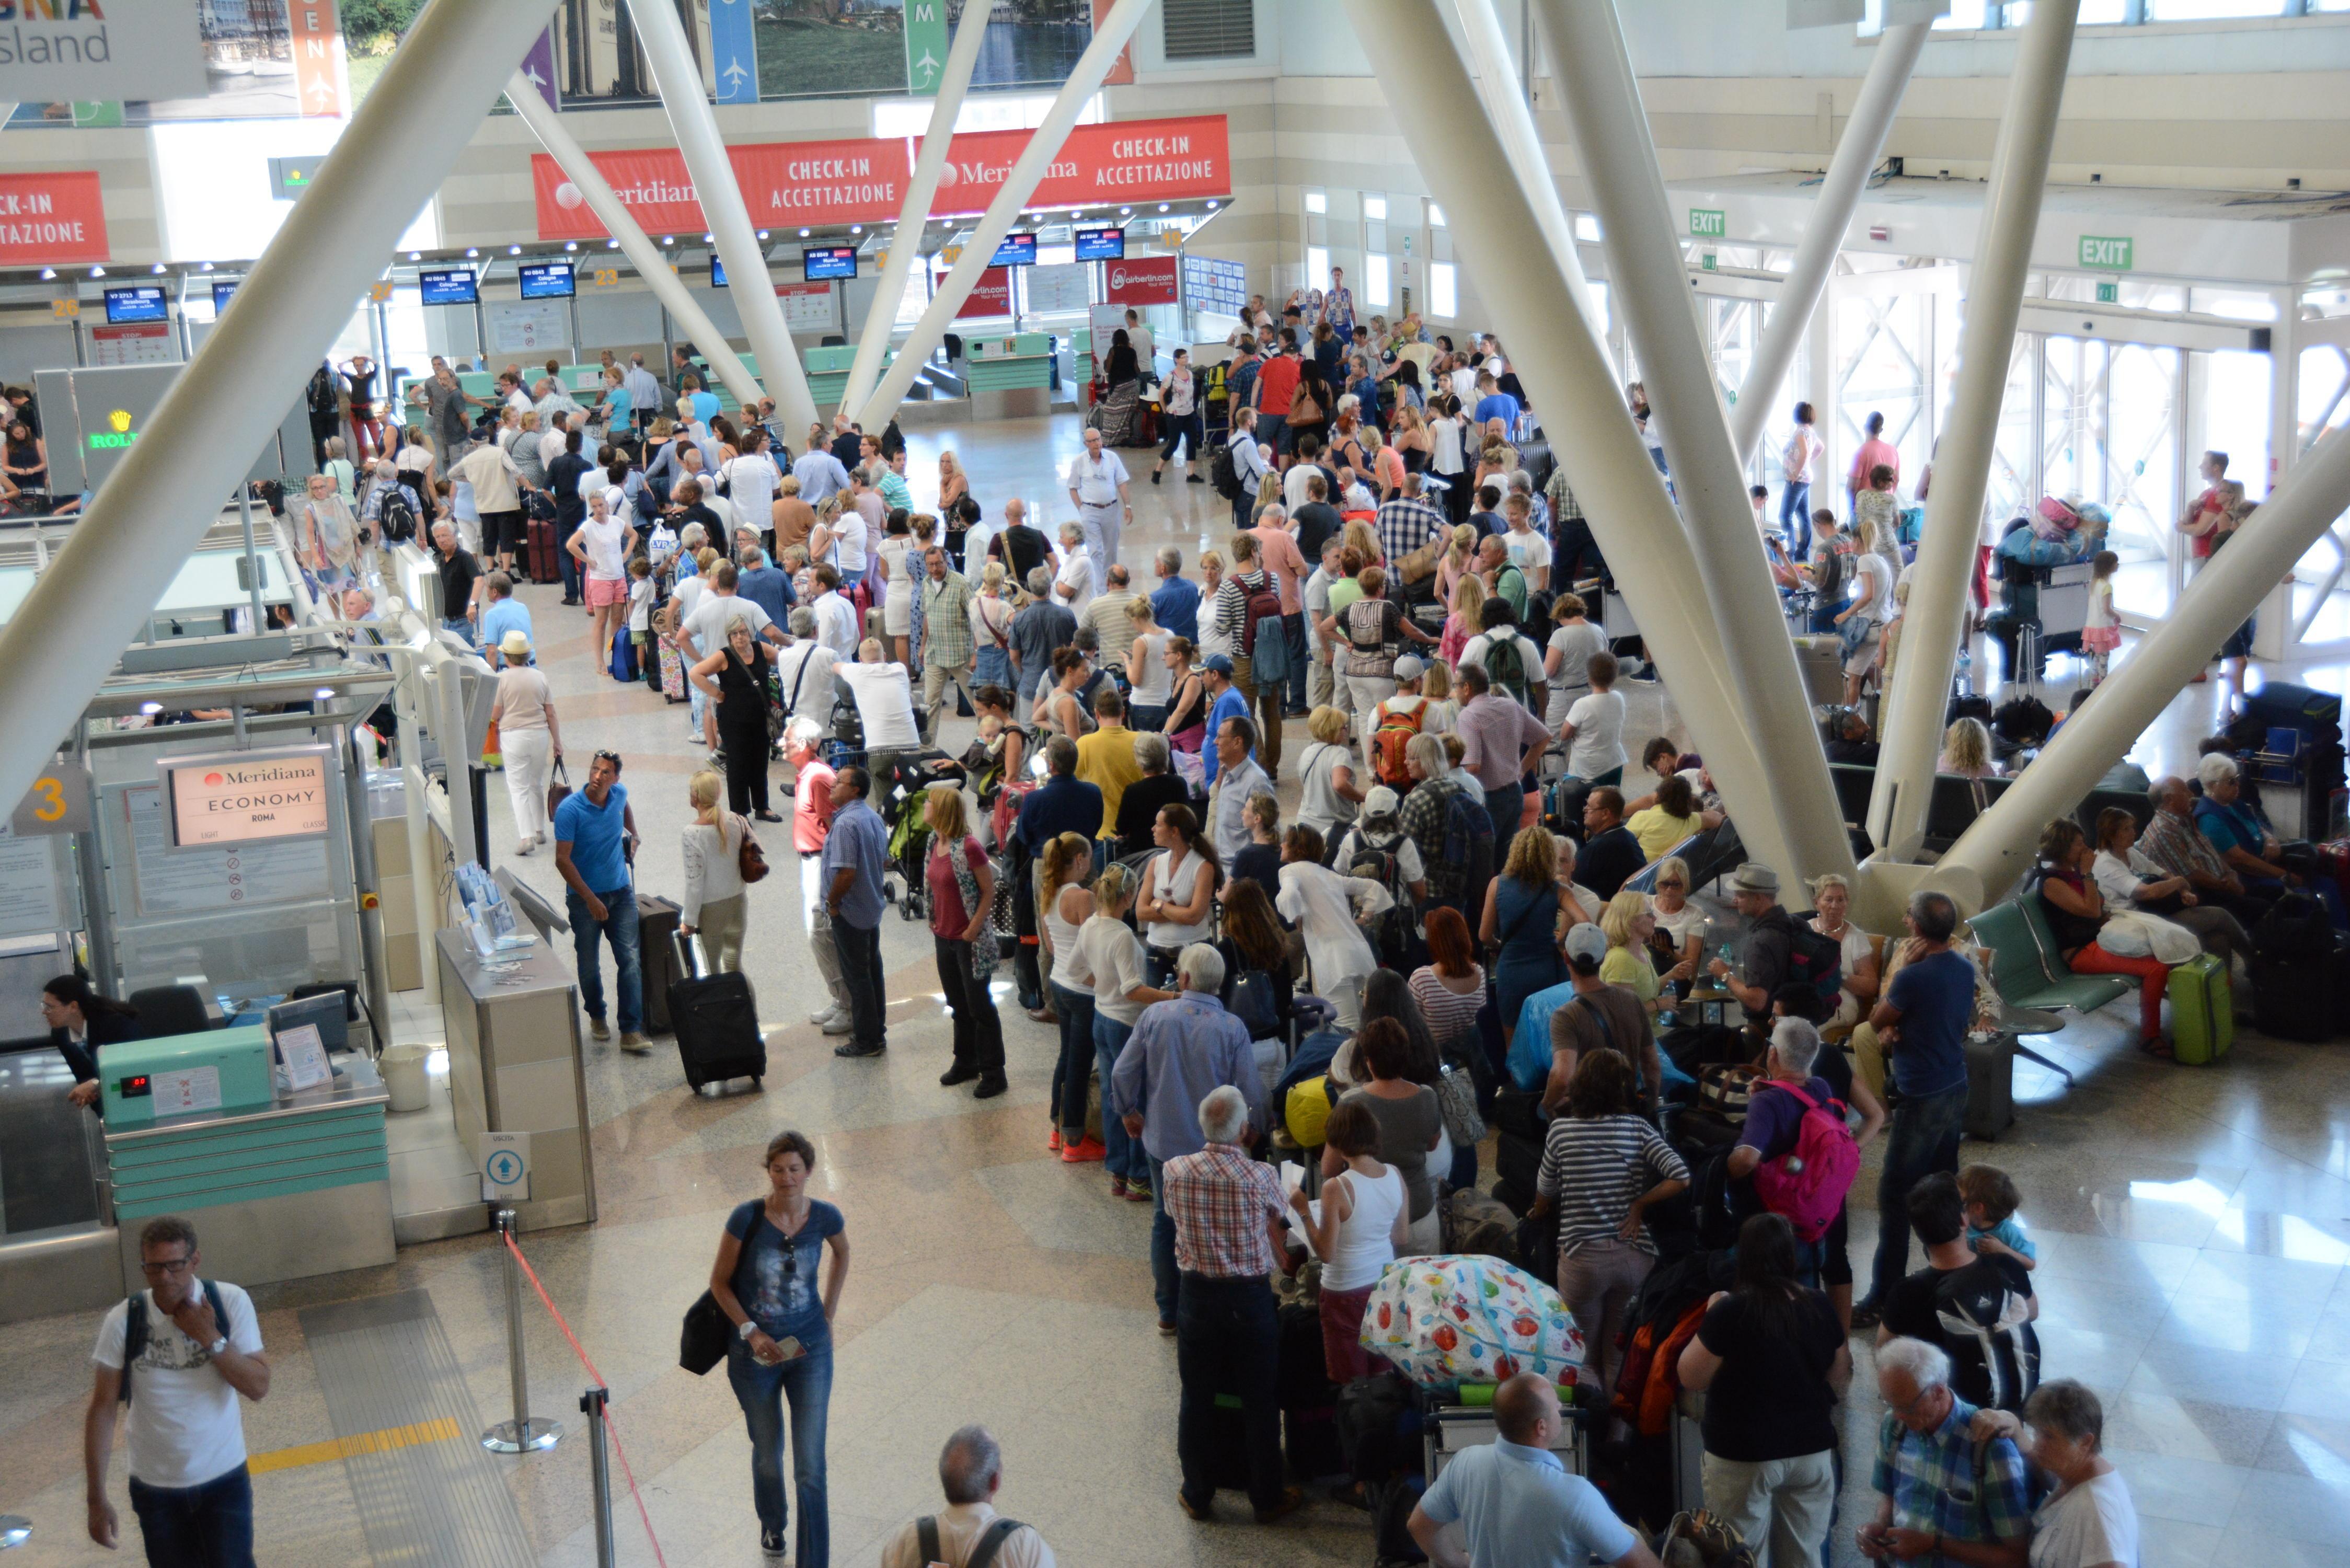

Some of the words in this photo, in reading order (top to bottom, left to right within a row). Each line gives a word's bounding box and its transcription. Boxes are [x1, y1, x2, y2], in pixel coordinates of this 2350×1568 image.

[1112, 136, 1189, 158] CHECK-IN
[789, 158, 870, 180] CHECK-IN
[960, 160, 1078, 185] Merina
[1096, 160, 1212, 186] ACCETTAZIONE
[613, 181, 699, 204] eridian
[772, 183, 894, 208] ACCETTAZIONE
[1691, 212, 1722, 233] EXIT
[1162, 231, 1181, 247] 19
[878, 252, 888, 268] 2
[2082, 240, 2128, 265] EXIT
[595, 269, 618, 286] 23
[1125, 274, 1174, 284] airberlin.com
[53, 299, 79, 317] 26
[90, 432, 139, 448] ROL
[226, 767, 316, 785] Meridiana
[33, 777, 67, 822] 3
[209, 790, 315, 811] ECONOMY
[252, 813, 275, 823] ROMA
[303, 820, 327, 828] CLASSIC
